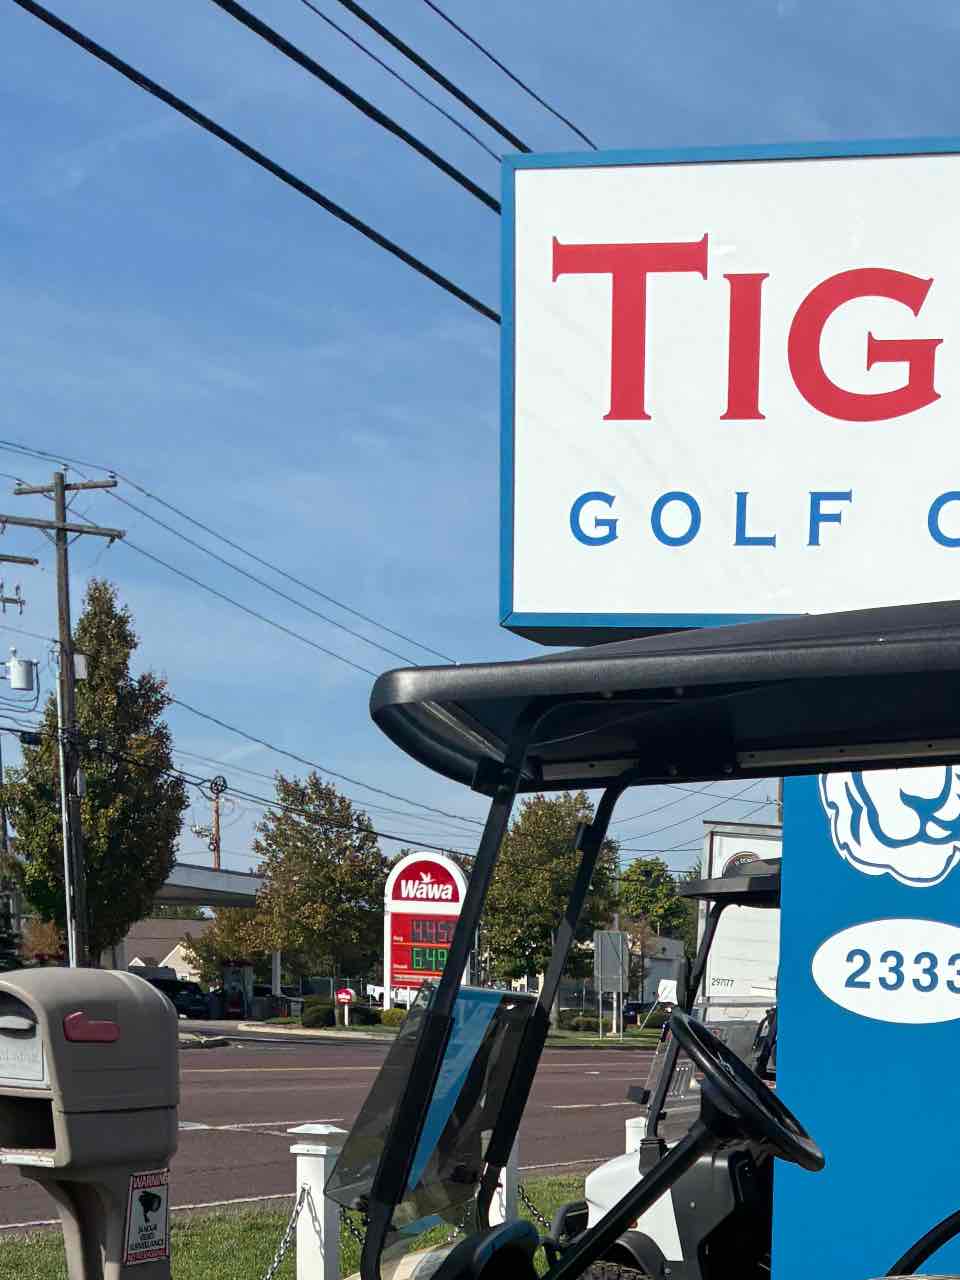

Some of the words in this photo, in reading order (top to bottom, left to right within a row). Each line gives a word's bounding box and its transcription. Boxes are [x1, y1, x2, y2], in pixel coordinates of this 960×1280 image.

[569, 490, 853, 547] GOLF
[401, 879, 454, 900] Wawa
[133, 1173, 169, 1188] WARNING
